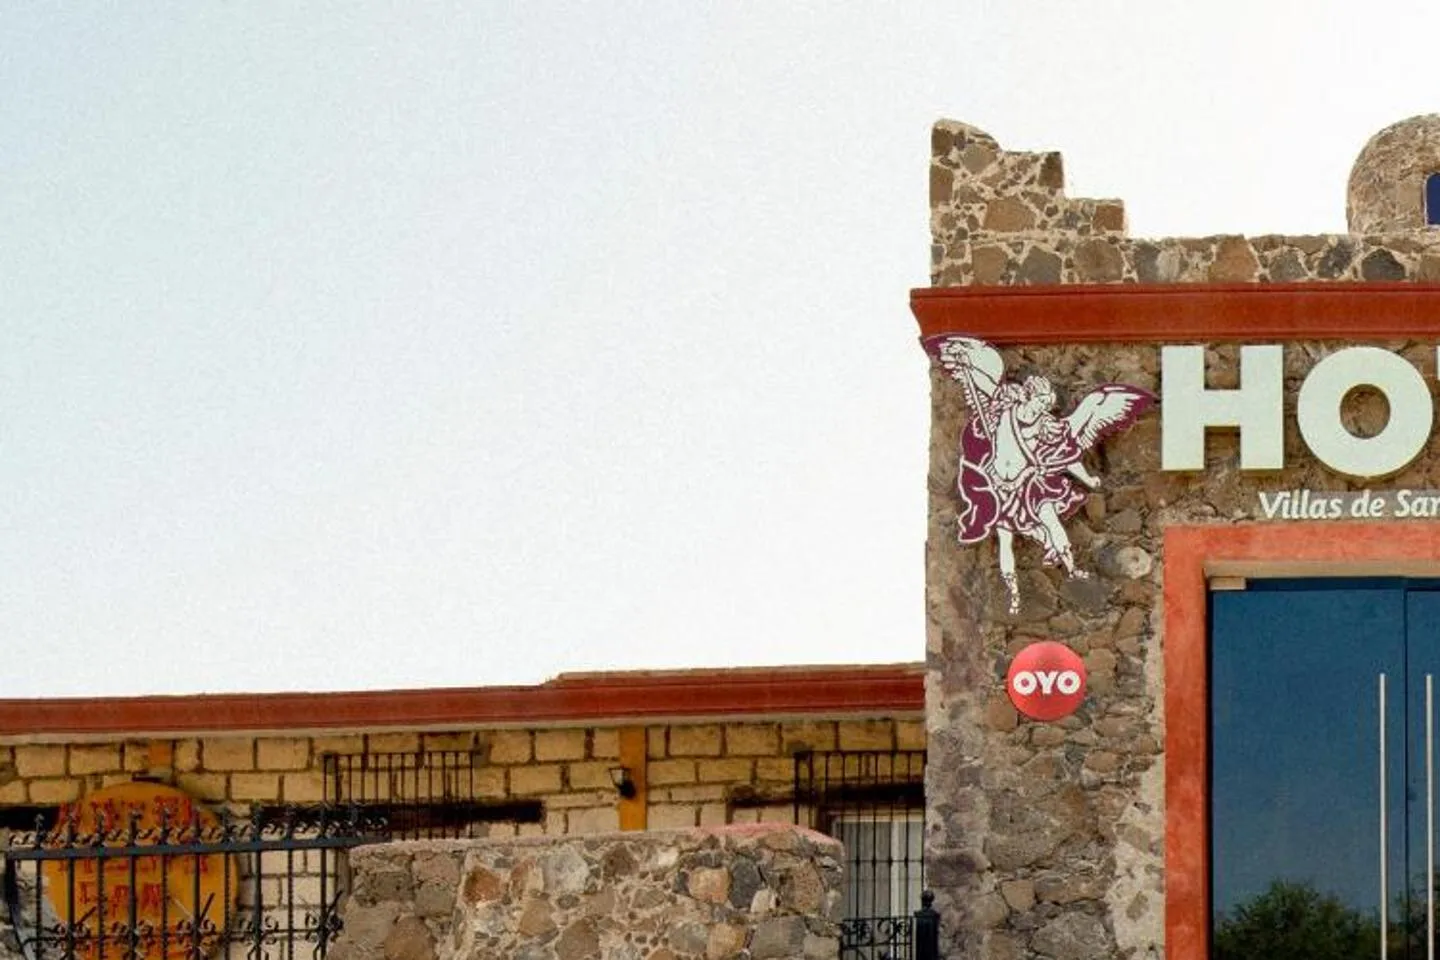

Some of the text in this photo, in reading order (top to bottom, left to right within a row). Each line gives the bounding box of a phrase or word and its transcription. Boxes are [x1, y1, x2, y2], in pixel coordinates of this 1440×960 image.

[1258, 489, 1343, 519] Villas
[1351, 489, 1385, 518] de
[1013, 670, 1081, 695] OYO
